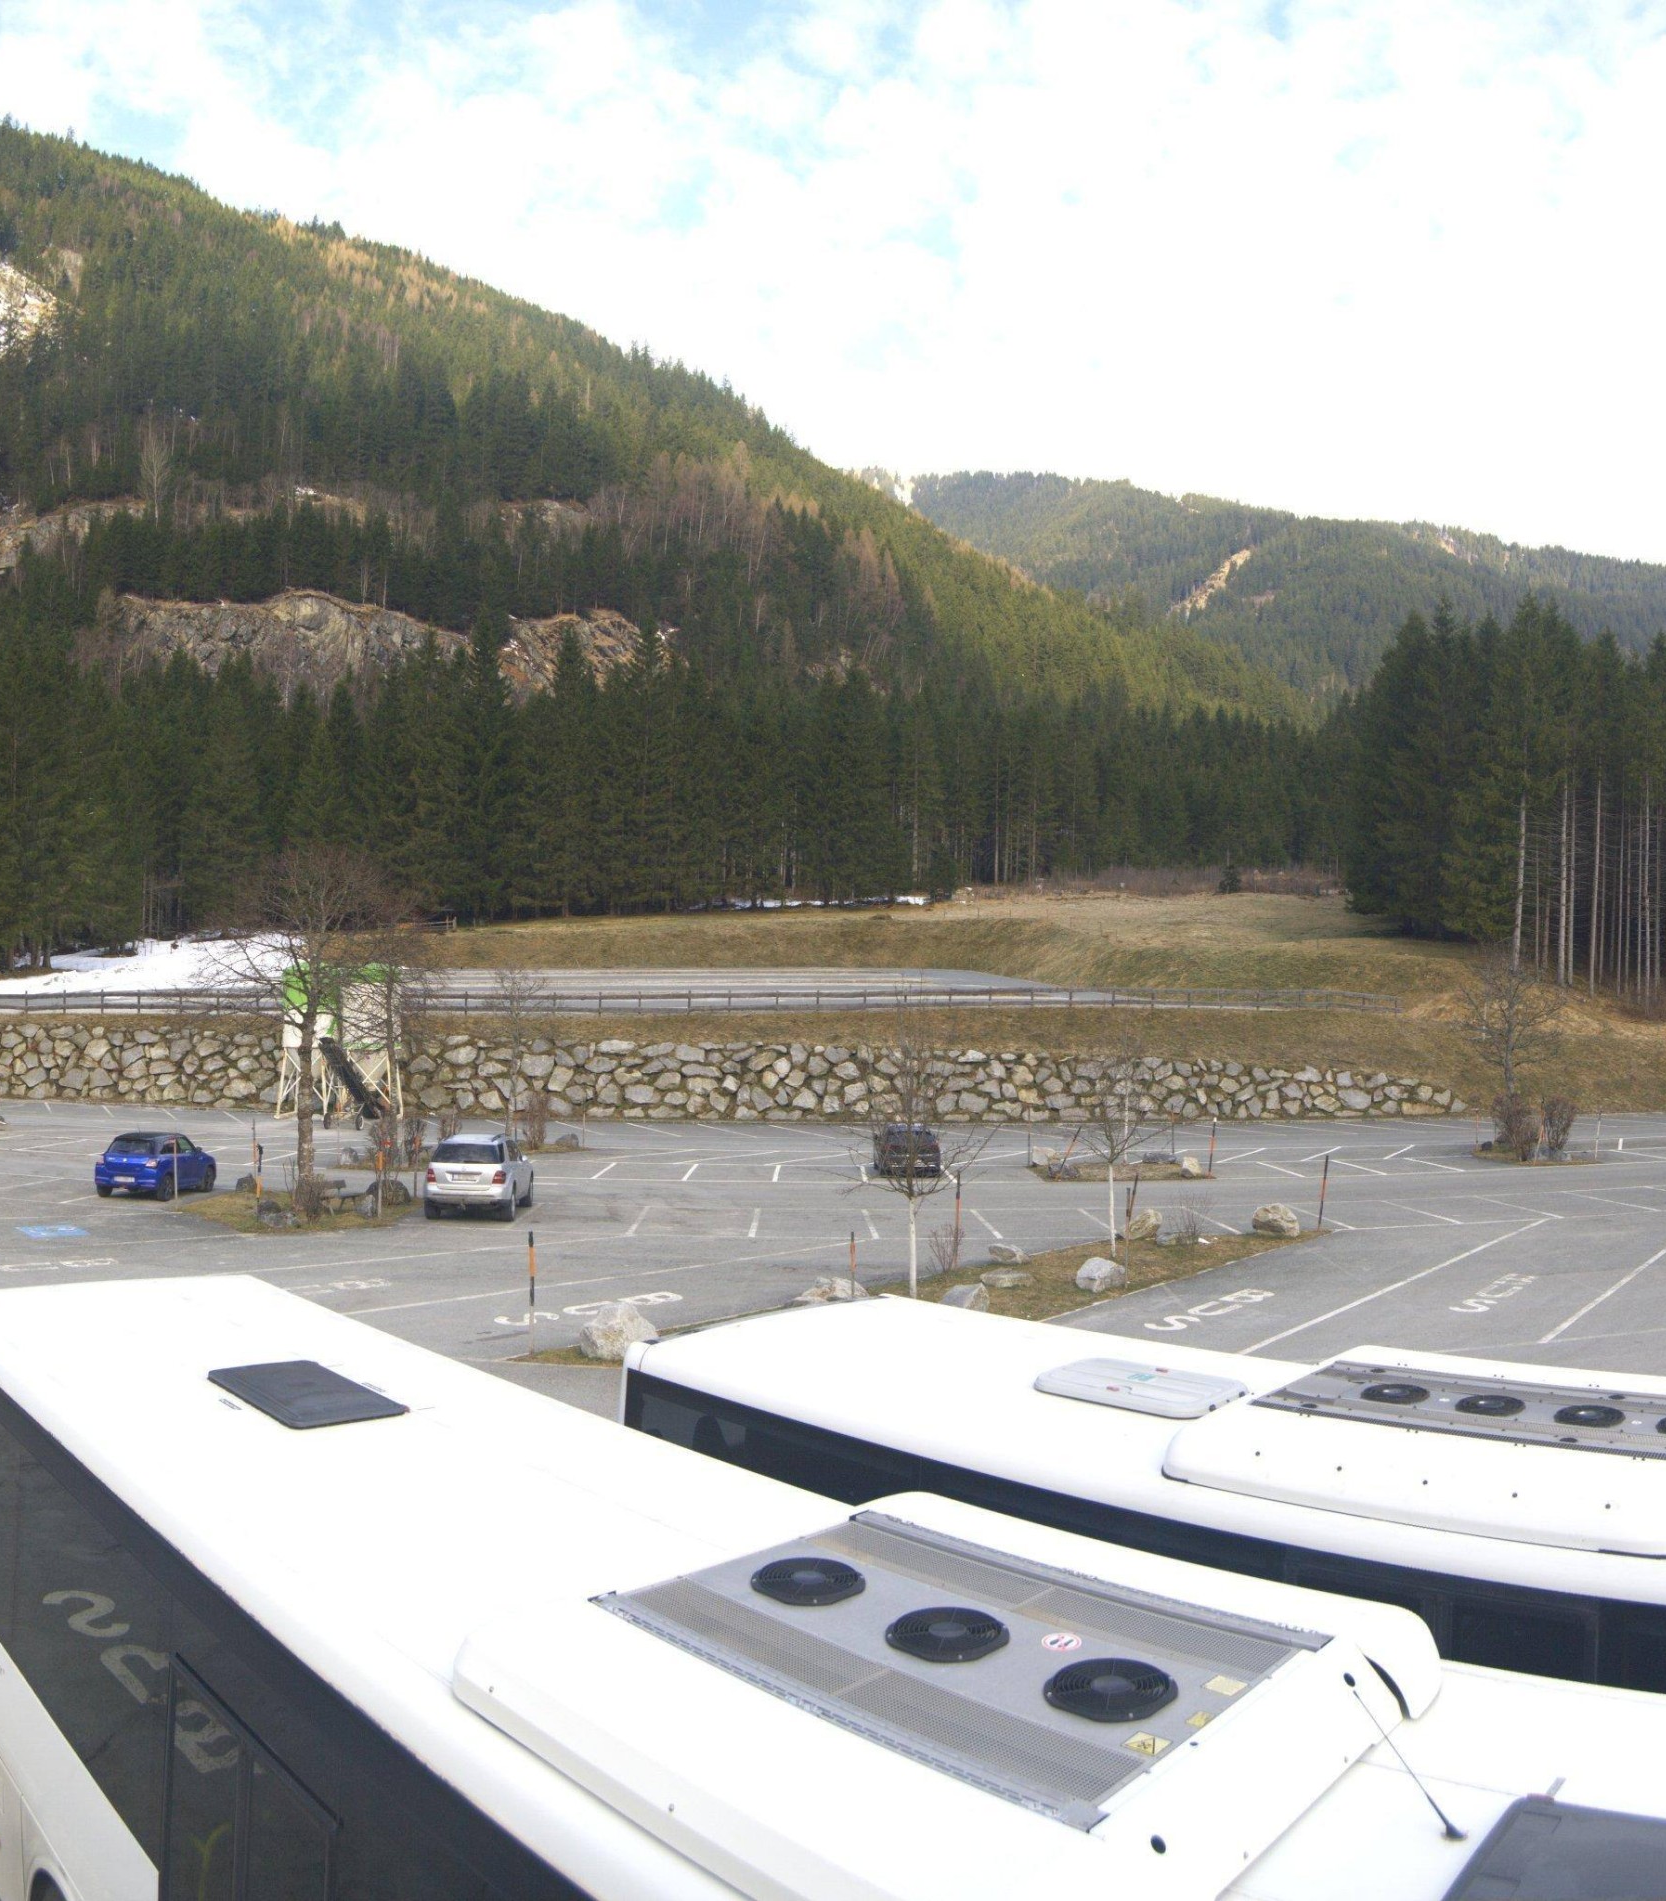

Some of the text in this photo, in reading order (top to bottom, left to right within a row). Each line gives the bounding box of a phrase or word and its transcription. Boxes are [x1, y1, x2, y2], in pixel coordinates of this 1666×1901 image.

[493, 1291, 684, 1327] BUS
[1144, 1288, 1276, 1332] BUS
[1448, 1272, 1538, 1314] BUS
